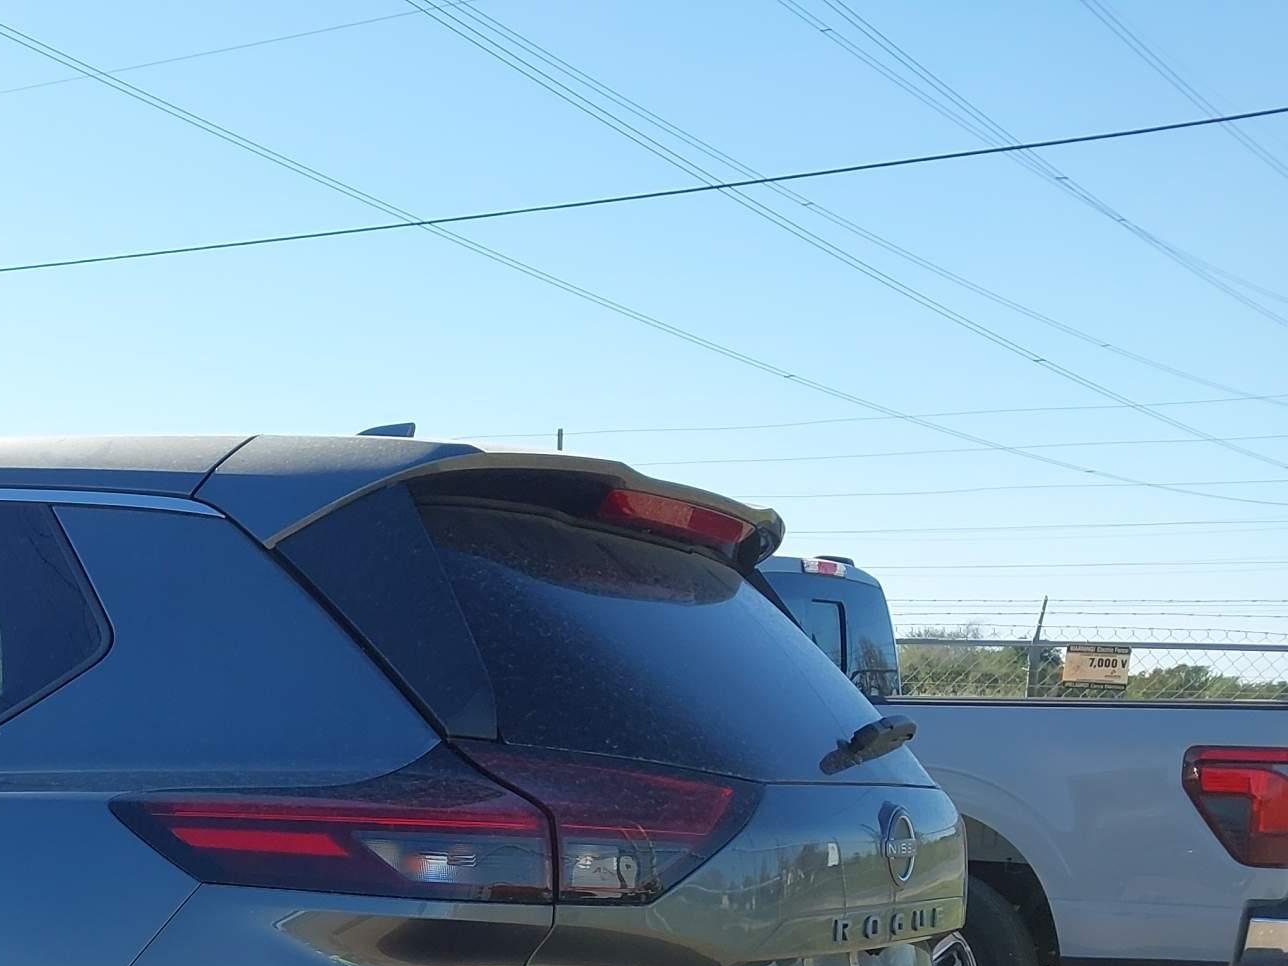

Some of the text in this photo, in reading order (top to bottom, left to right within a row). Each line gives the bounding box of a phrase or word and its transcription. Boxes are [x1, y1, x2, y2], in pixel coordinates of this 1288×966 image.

[1088, 657, 1128, 669] 7,000 V
[833, 906, 946, 945] ROGUE
